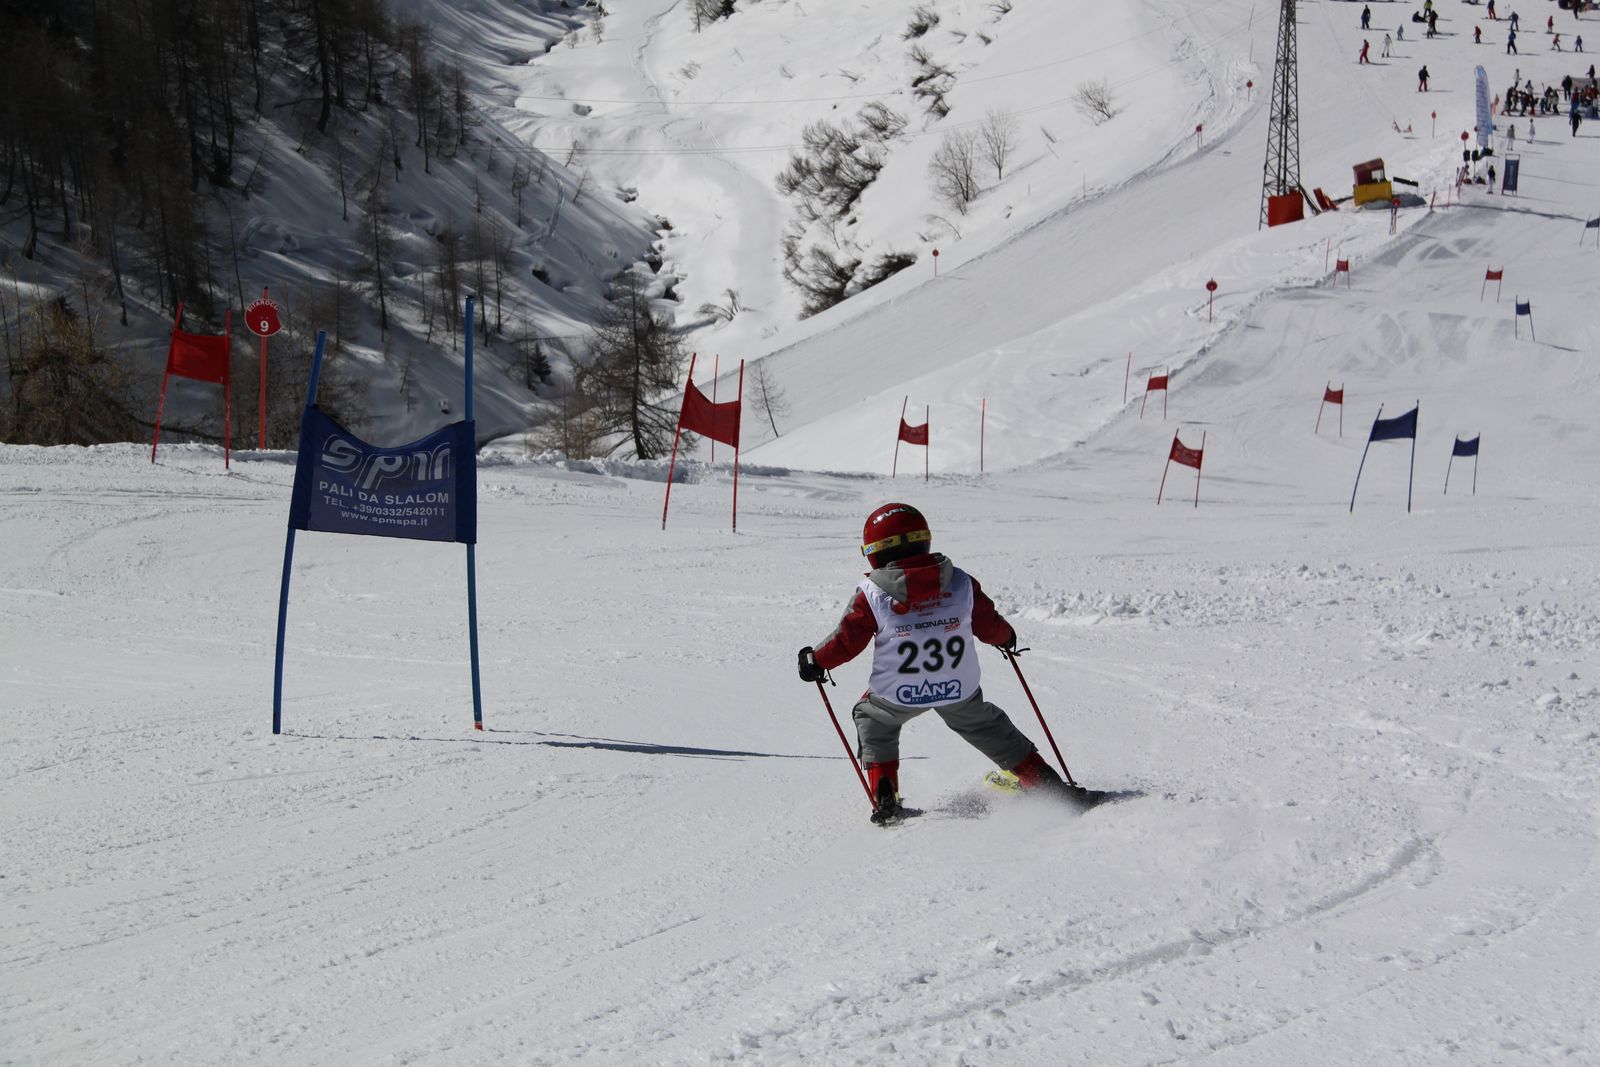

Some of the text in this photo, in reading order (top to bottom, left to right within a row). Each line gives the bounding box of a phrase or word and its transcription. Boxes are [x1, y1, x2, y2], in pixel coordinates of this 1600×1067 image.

[260, 320, 269, 333] 9
[319, 480, 449, 505] PALI DA SLALOM
[323, 495, 445, 517] TEL. +39/0332/542011
[341, 510, 428, 527] www.spmspa.it
[914, 617, 960, 630] BONALDI
[897, 635, 965, 674] 239
[897, 679, 961, 704] CLAN2
